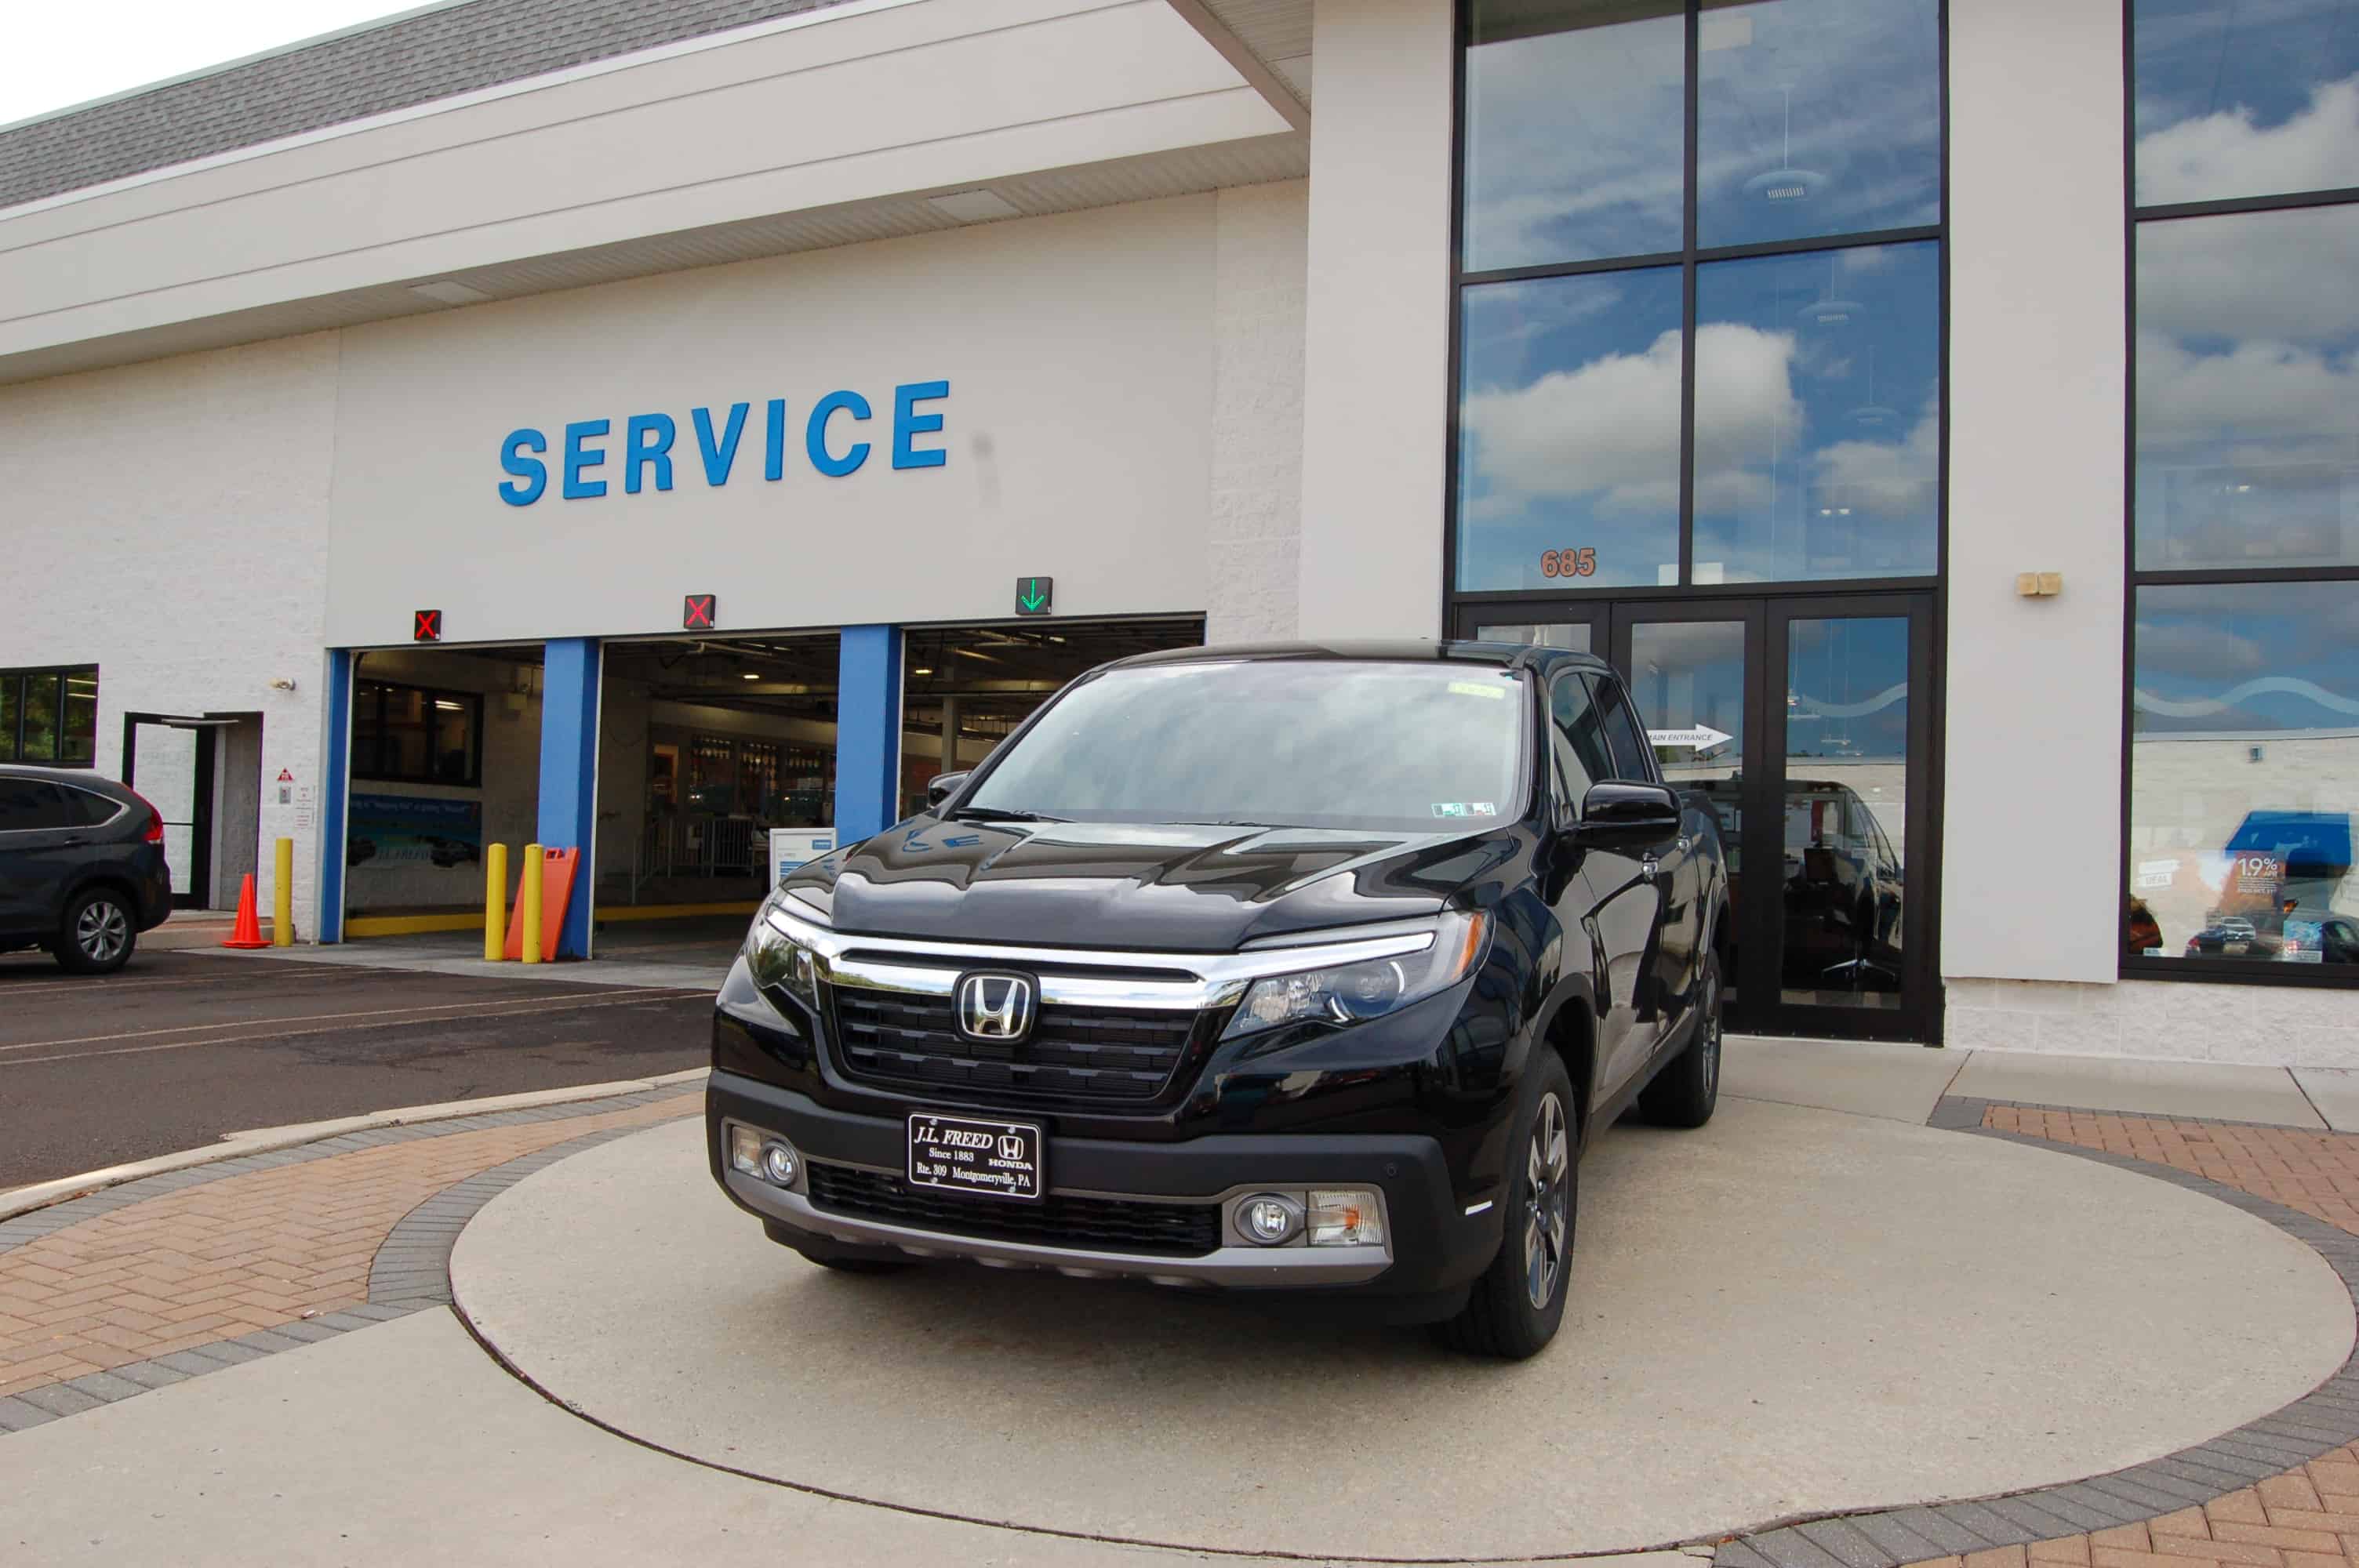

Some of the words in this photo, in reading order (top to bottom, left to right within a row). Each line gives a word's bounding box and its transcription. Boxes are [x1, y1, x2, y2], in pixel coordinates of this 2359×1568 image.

[498, 379, 950, 507] SERVICE
[1541, 547, 1595, 578] 685
[2238, 858, 2278, 877] 1.9%
[914, 1126, 940, 1144] J.L.
[942, 1129, 994, 1149] FREED
[929, 1147, 952, 1160] Since
[954, 1149, 974, 1162] 1883
[988, 1158, 1034, 1171] HONDA
[916, 1161, 932, 1174] Rte.
[932, 1163, 947, 1177] 309
[953, 1166, 1017, 1186] Montgomeryville,
[1017, 1174, 1031, 1187] PA
